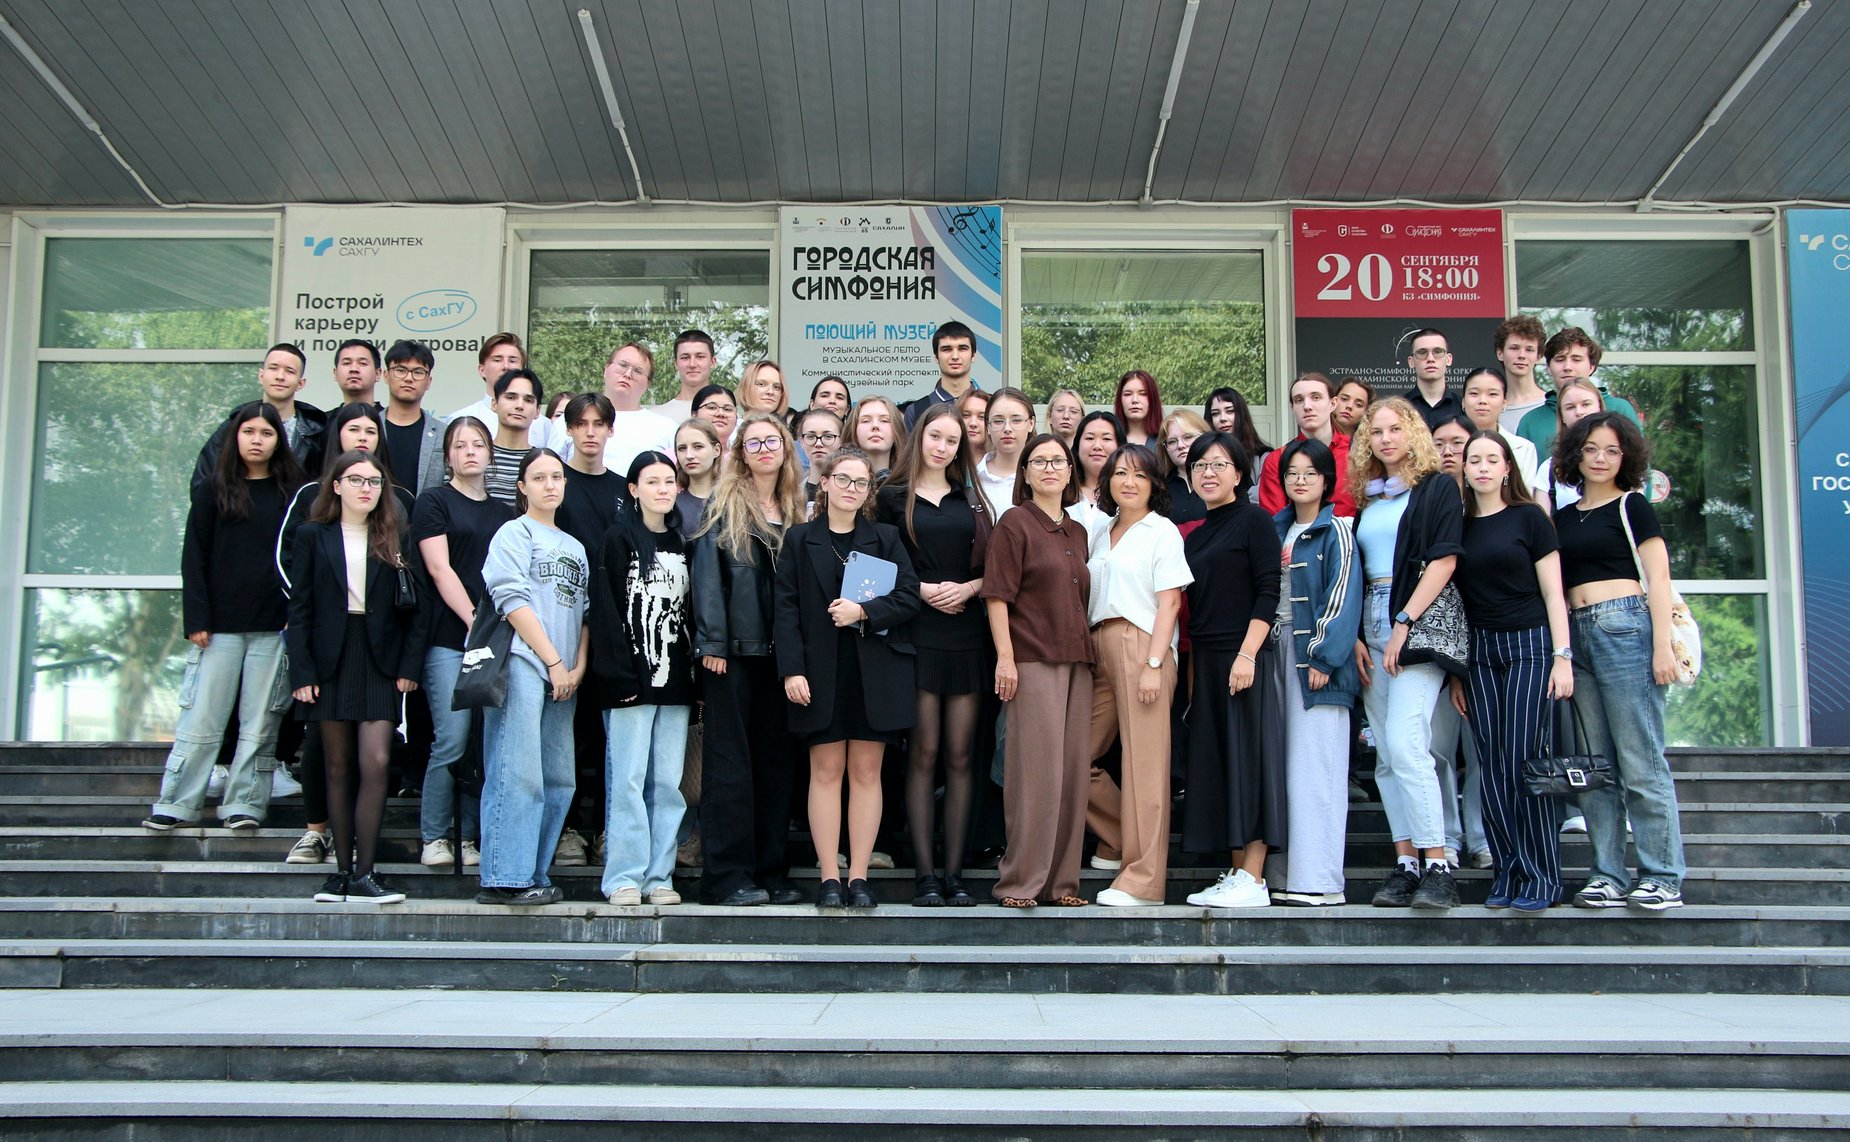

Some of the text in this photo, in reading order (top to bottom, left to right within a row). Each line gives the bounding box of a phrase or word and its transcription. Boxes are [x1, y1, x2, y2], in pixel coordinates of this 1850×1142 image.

[339, 237, 423, 246] САХАЛИНТЕХ
[339, 247, 380, 256] САХГУ
[793, 246, 935, 272] ГОРОДСКАЯ
[1401, 255, 1479, 266] СЕНТЯБРЯ
[1317, 253, 1393, 301] 20
[1403, 267, 1479, 289] 18:00
[792, 274, 936, 301] СИМФОНИЯ
[296, 292, 384, 313] Построй
[1402, 292, 1415, 300] КЗ
[419, 301, 464, 318] СахГУ
[294, 318, 379, 335] карьеру
[805, 320, 937, 341] ПОЮЩИЙ МУЗЕЙ
[294, 339, 305, 351] и
[822, 346, 921, 354] МУЗЫКАЛЬНОЕ ЛЕТО
[801, 369, 893, 377] Коммунистический
[892, 379, 915, 388] парк
